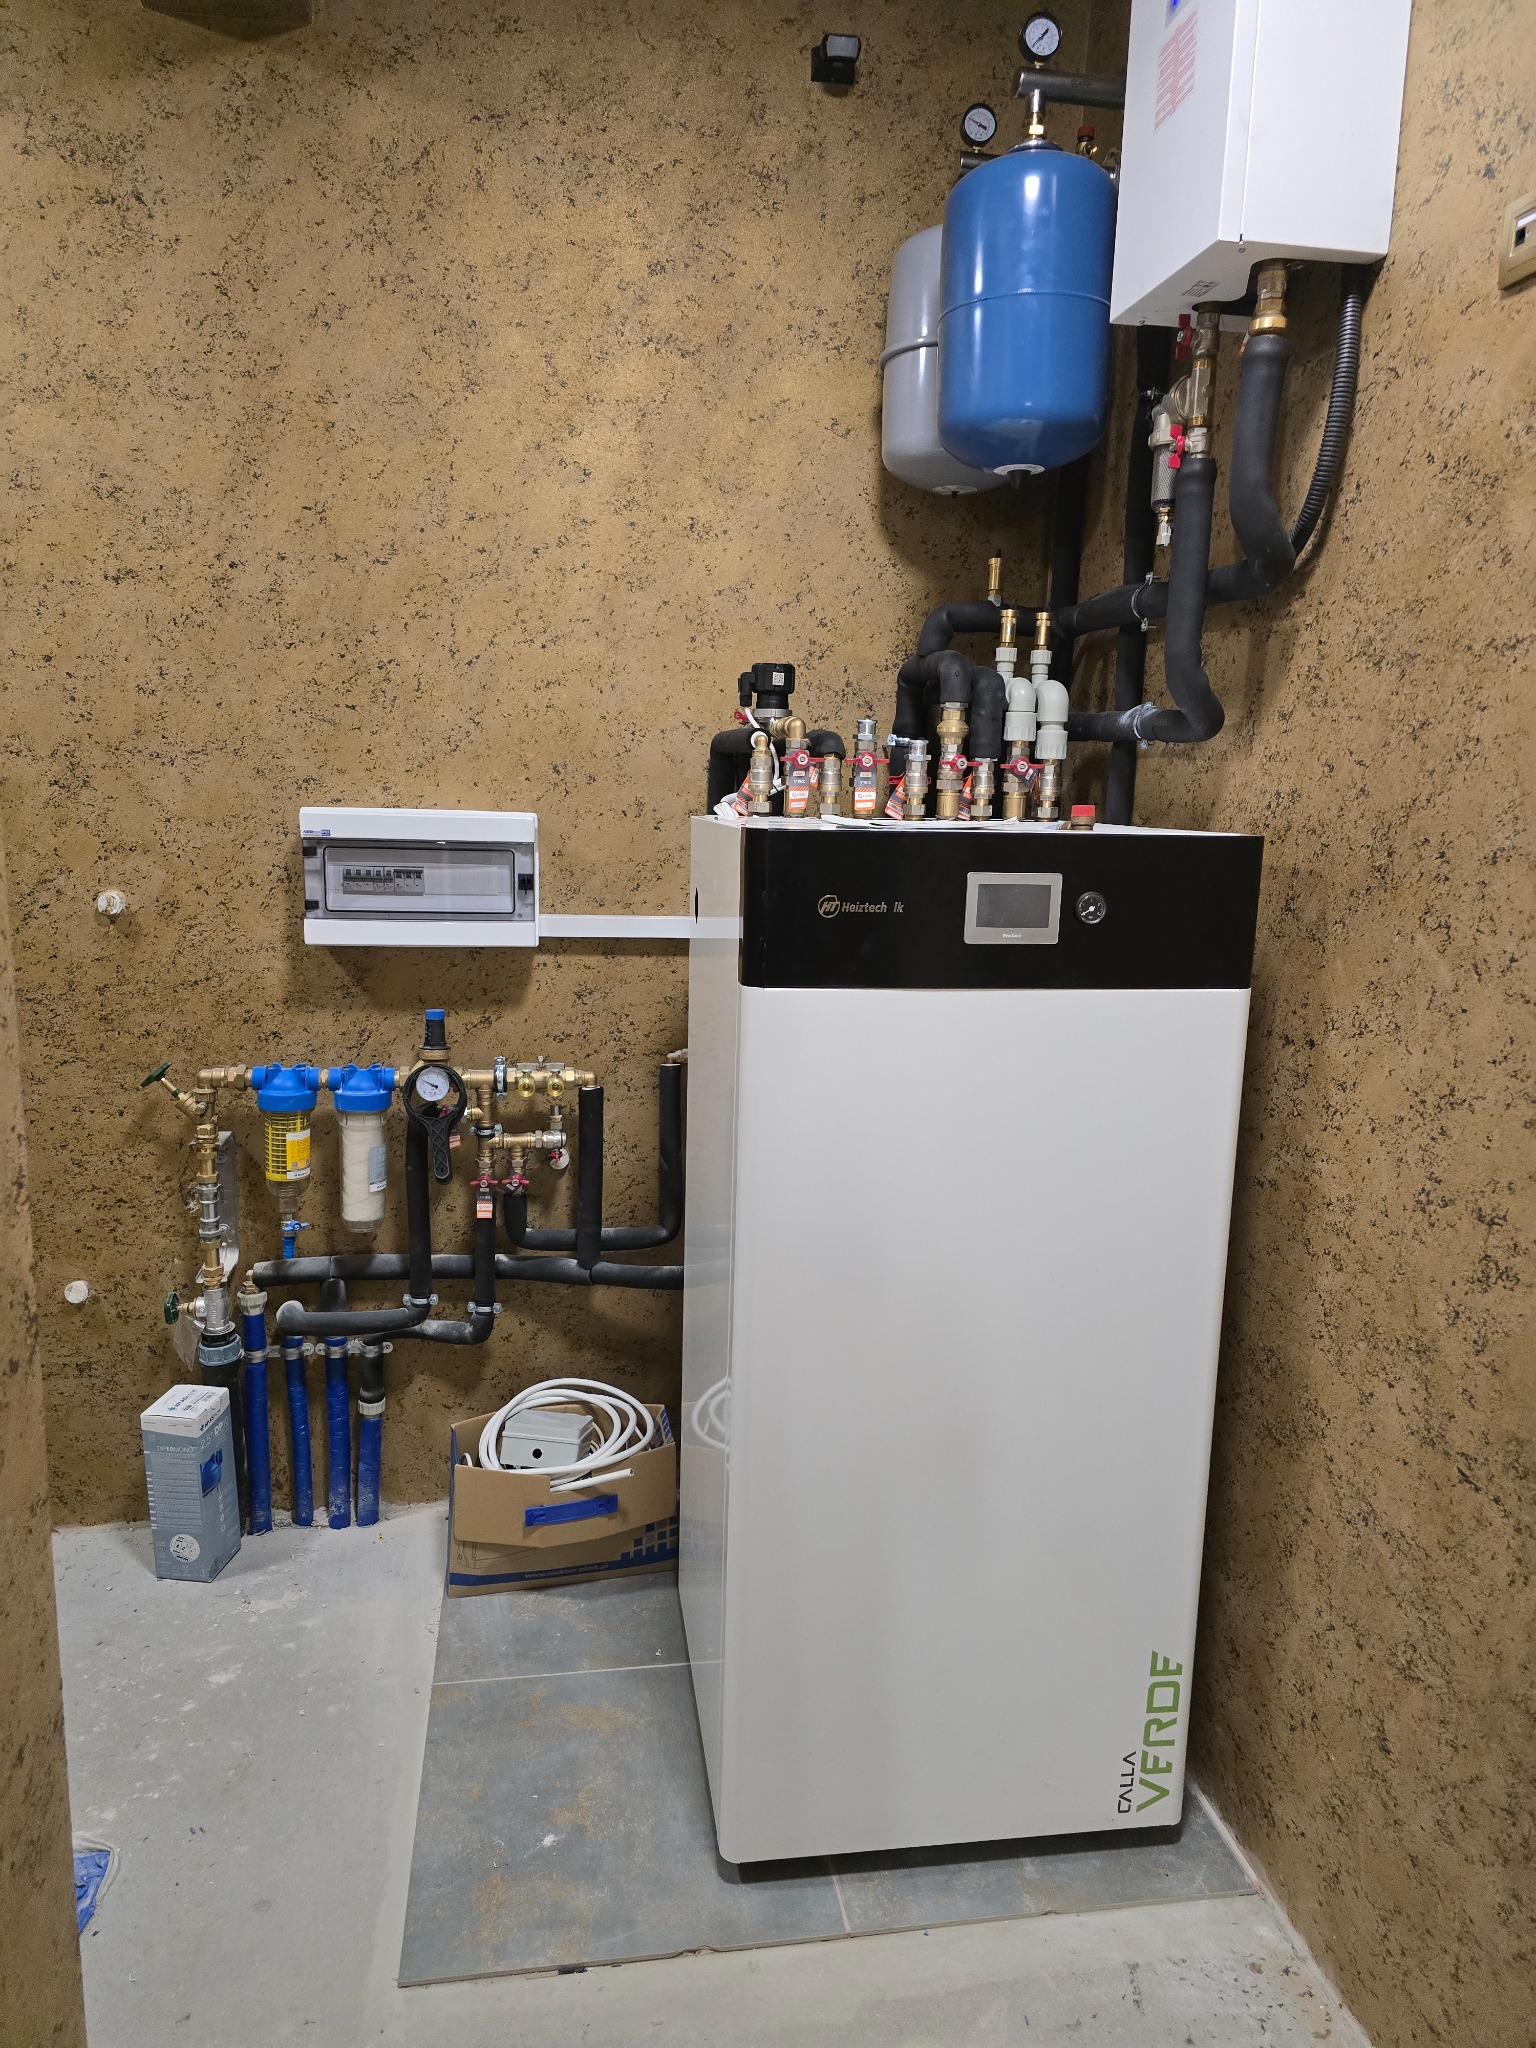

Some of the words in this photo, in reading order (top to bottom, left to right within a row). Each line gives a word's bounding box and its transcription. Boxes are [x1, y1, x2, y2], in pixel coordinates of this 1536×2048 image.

[841, 901, 888, 913] Heiztech
[893, 901, 905, 913] ik
[1135, 1650, 1184, 1813] VERDE
[1117, 1750, 1137, 1814] CALLA
